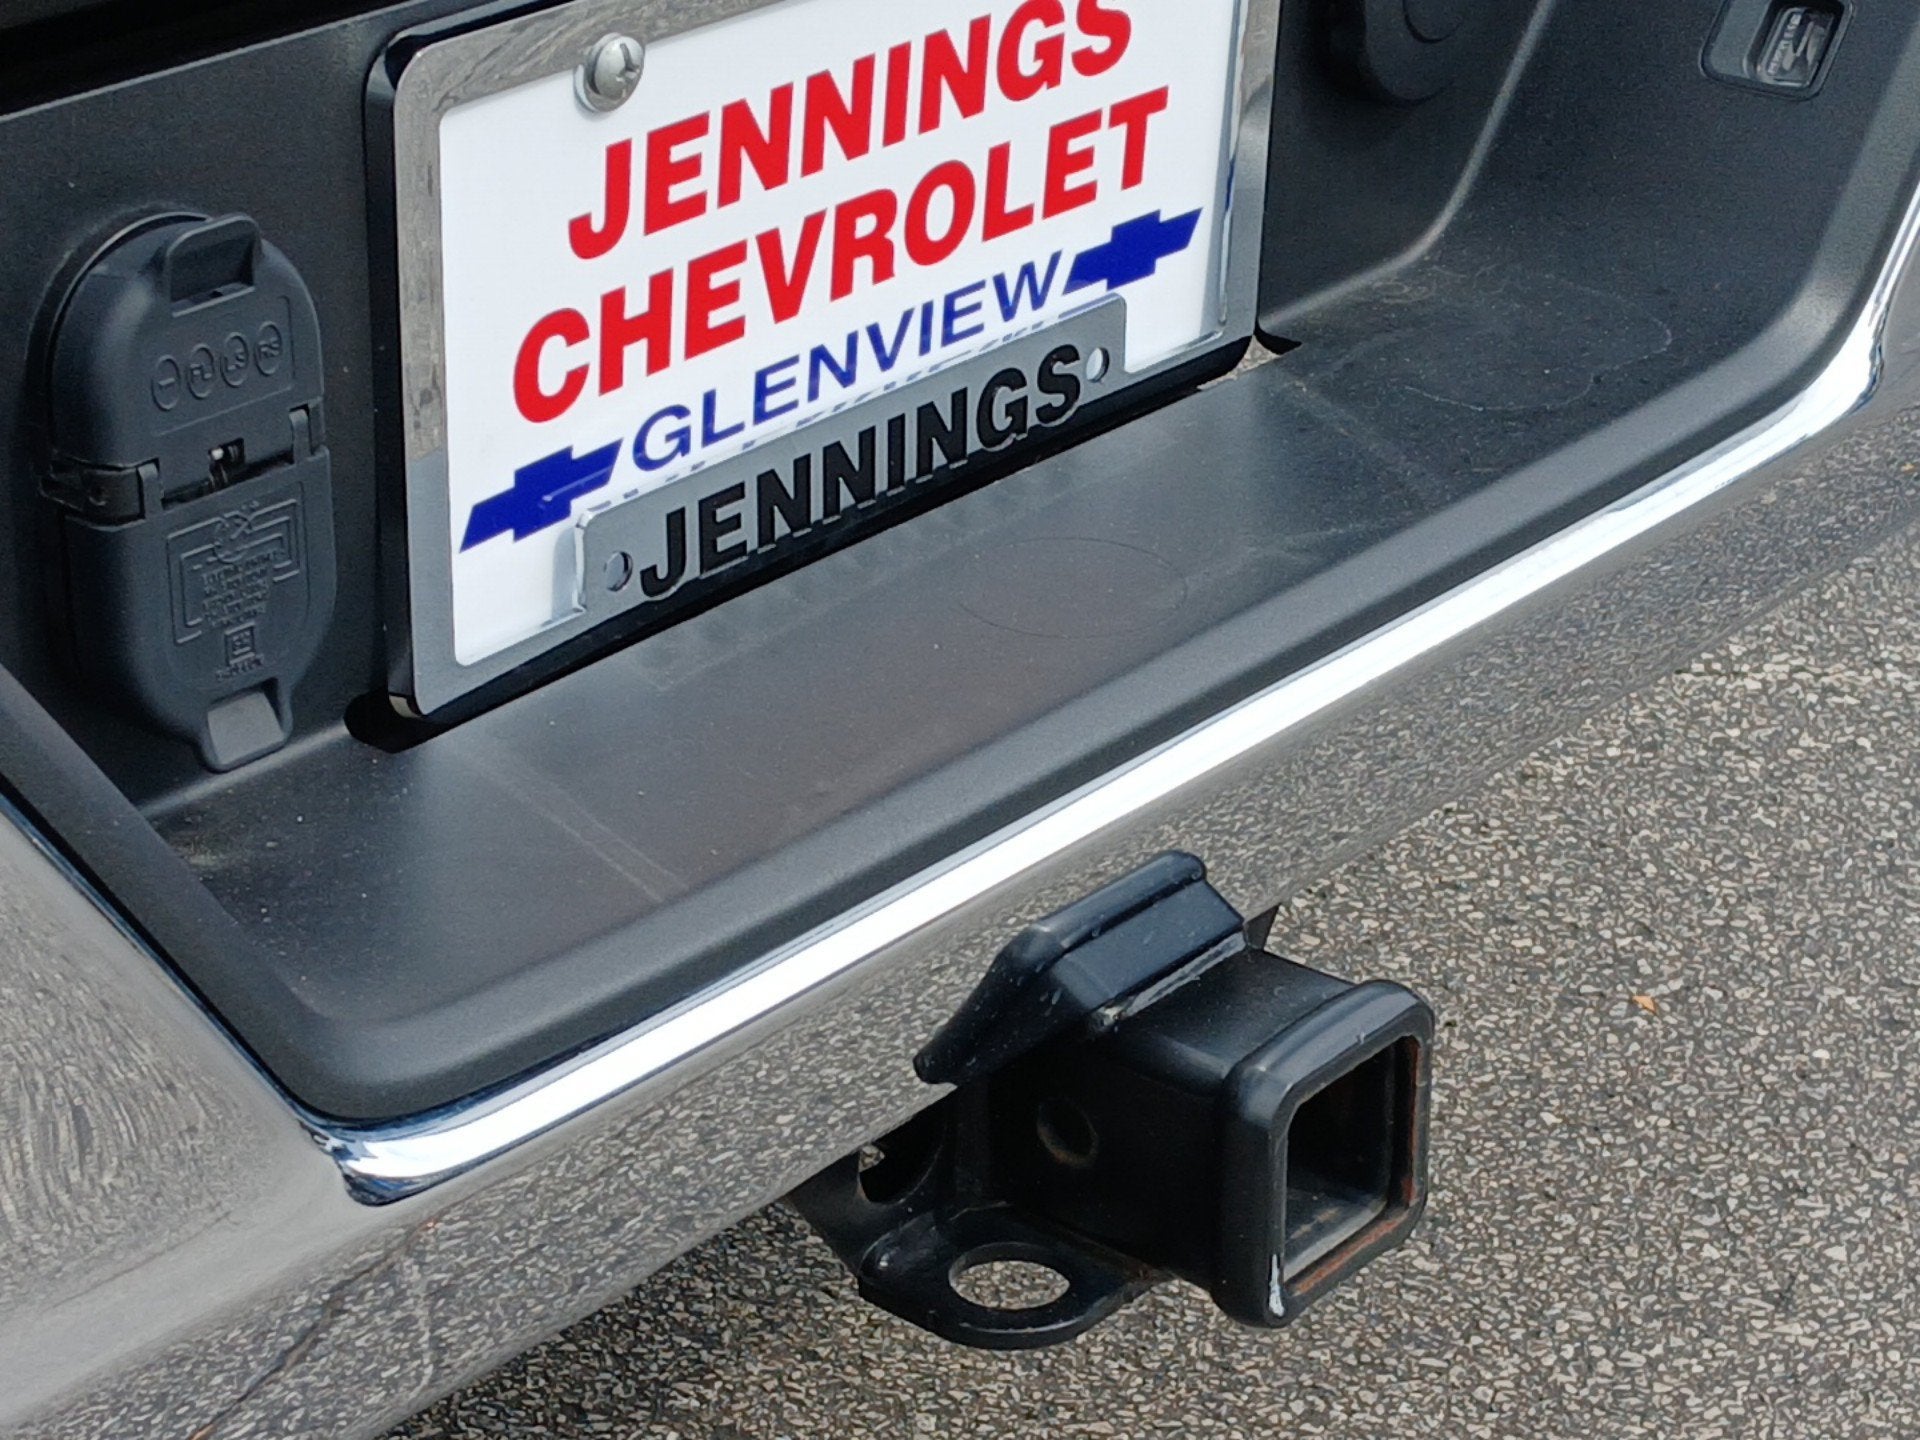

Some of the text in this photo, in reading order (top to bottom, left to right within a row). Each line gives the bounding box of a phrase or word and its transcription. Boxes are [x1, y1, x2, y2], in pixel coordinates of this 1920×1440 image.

[513, 87, 1169, 424] CHEVROLET
[568, 0, 1133, 262] JENNINGS
[631, 251, 1062, 473] GLENVIEW
[639, 343, 1083, 598] JENNINGS
